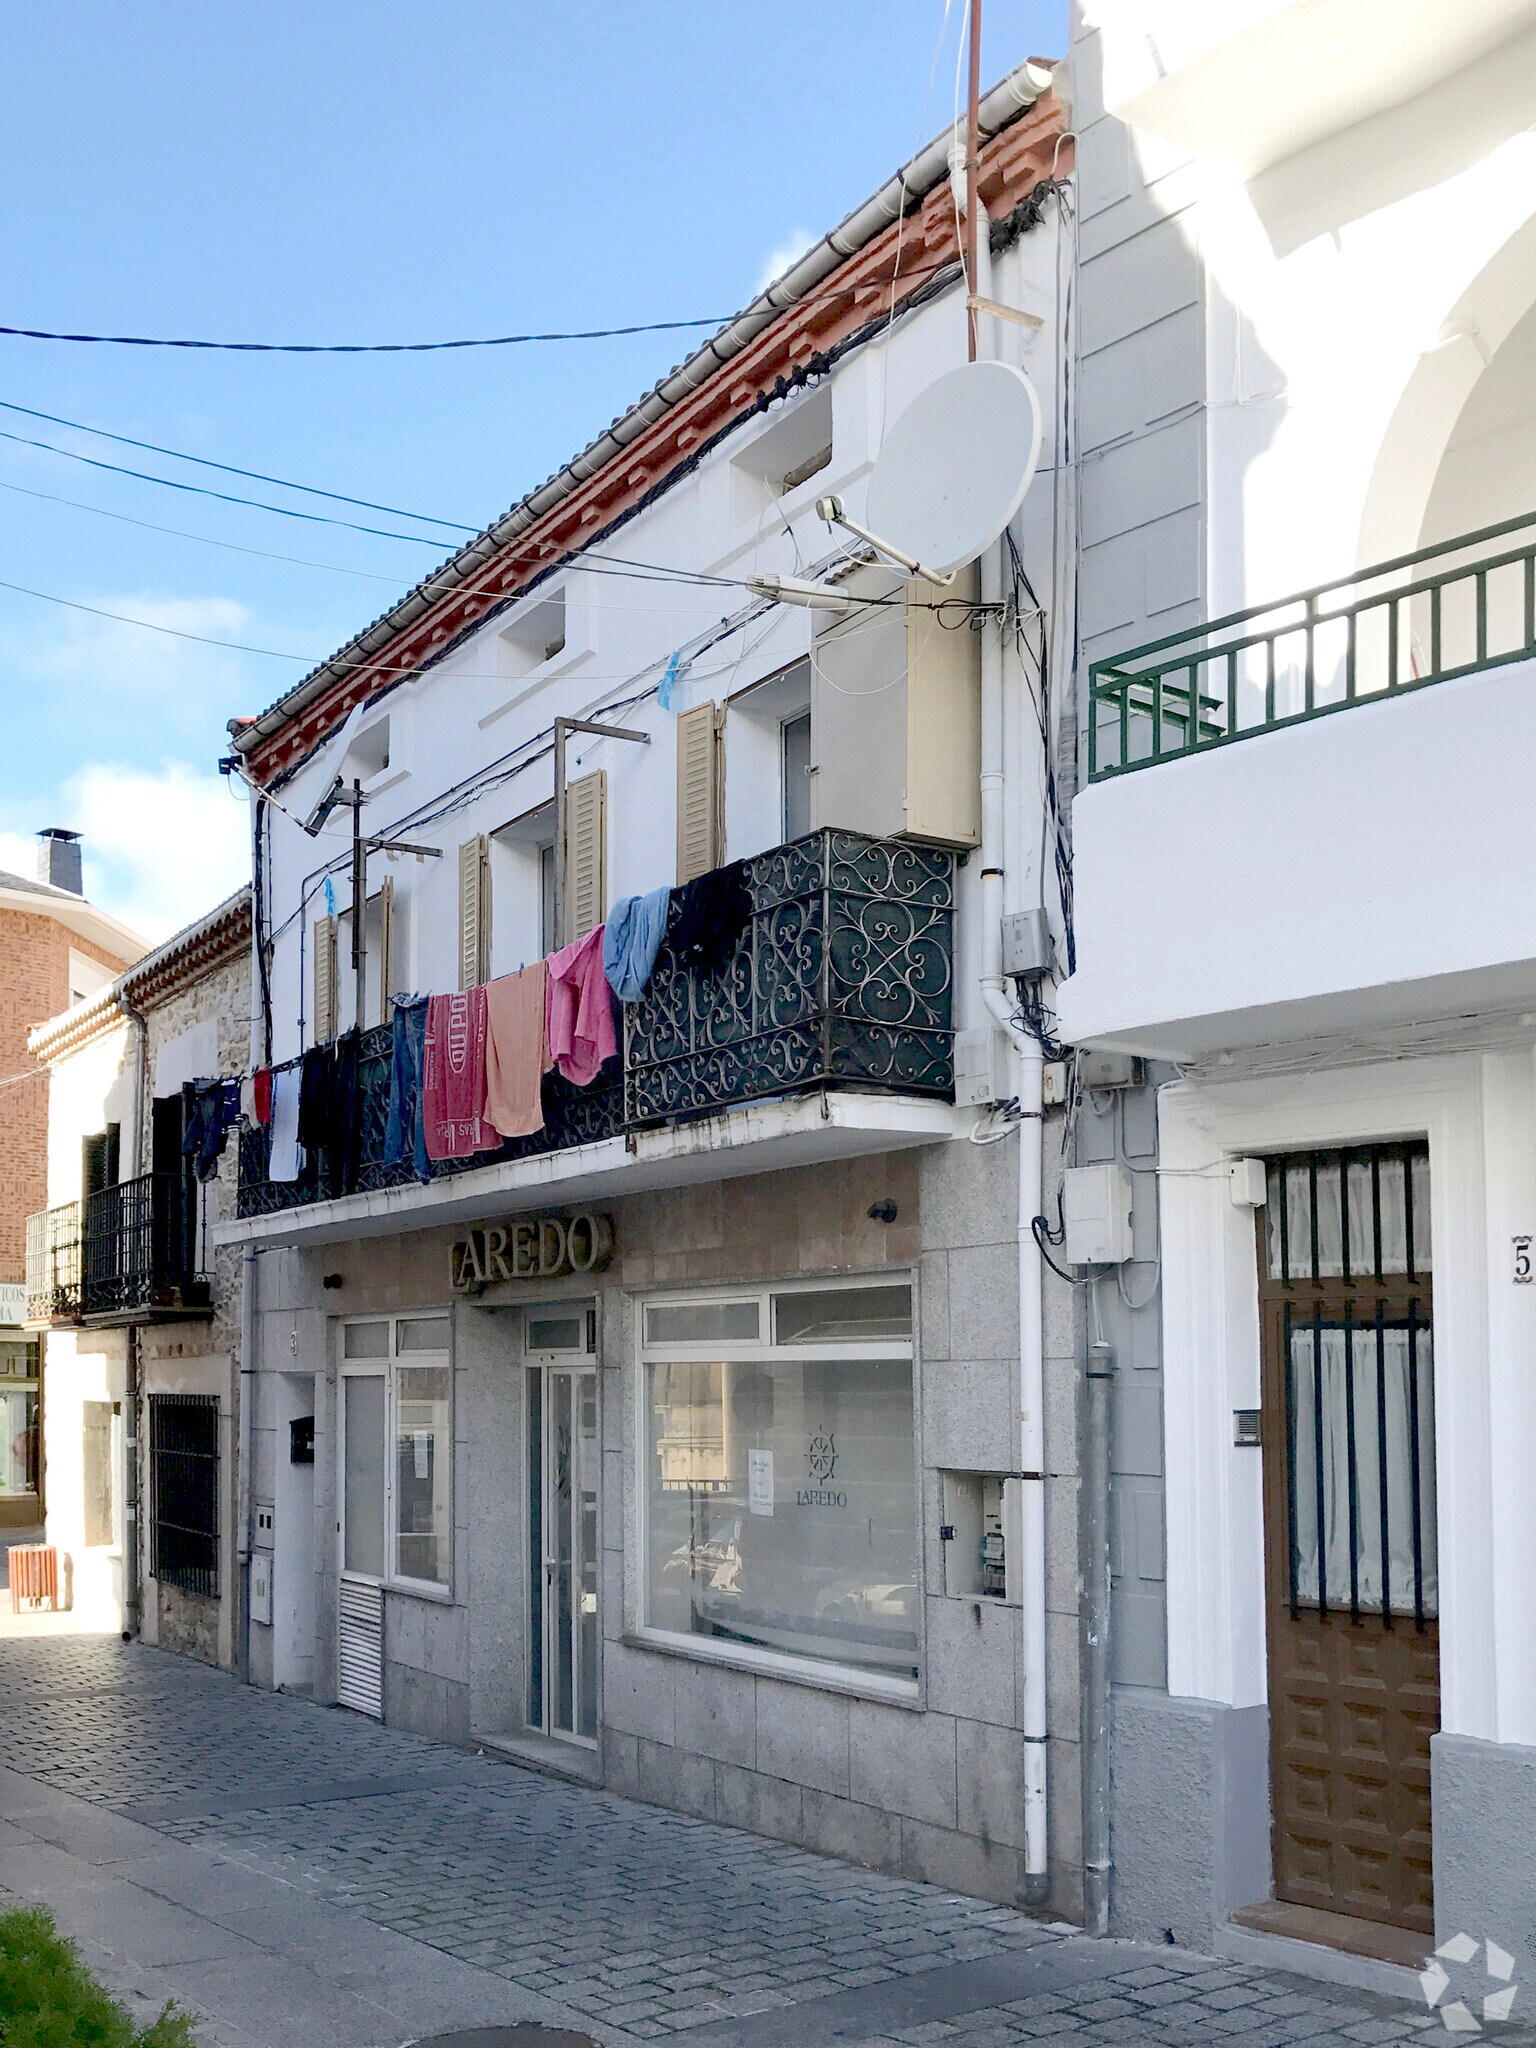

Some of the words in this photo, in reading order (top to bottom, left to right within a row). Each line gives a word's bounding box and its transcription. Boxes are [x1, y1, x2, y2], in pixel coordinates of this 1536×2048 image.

[448, 1213, 599, 1293] LAREDO
[1515, 1243, 1530, 1276] 5
[0, 1286, 25, 1303] ICOS
[796, 1490, 848, 1508] LAREDO
